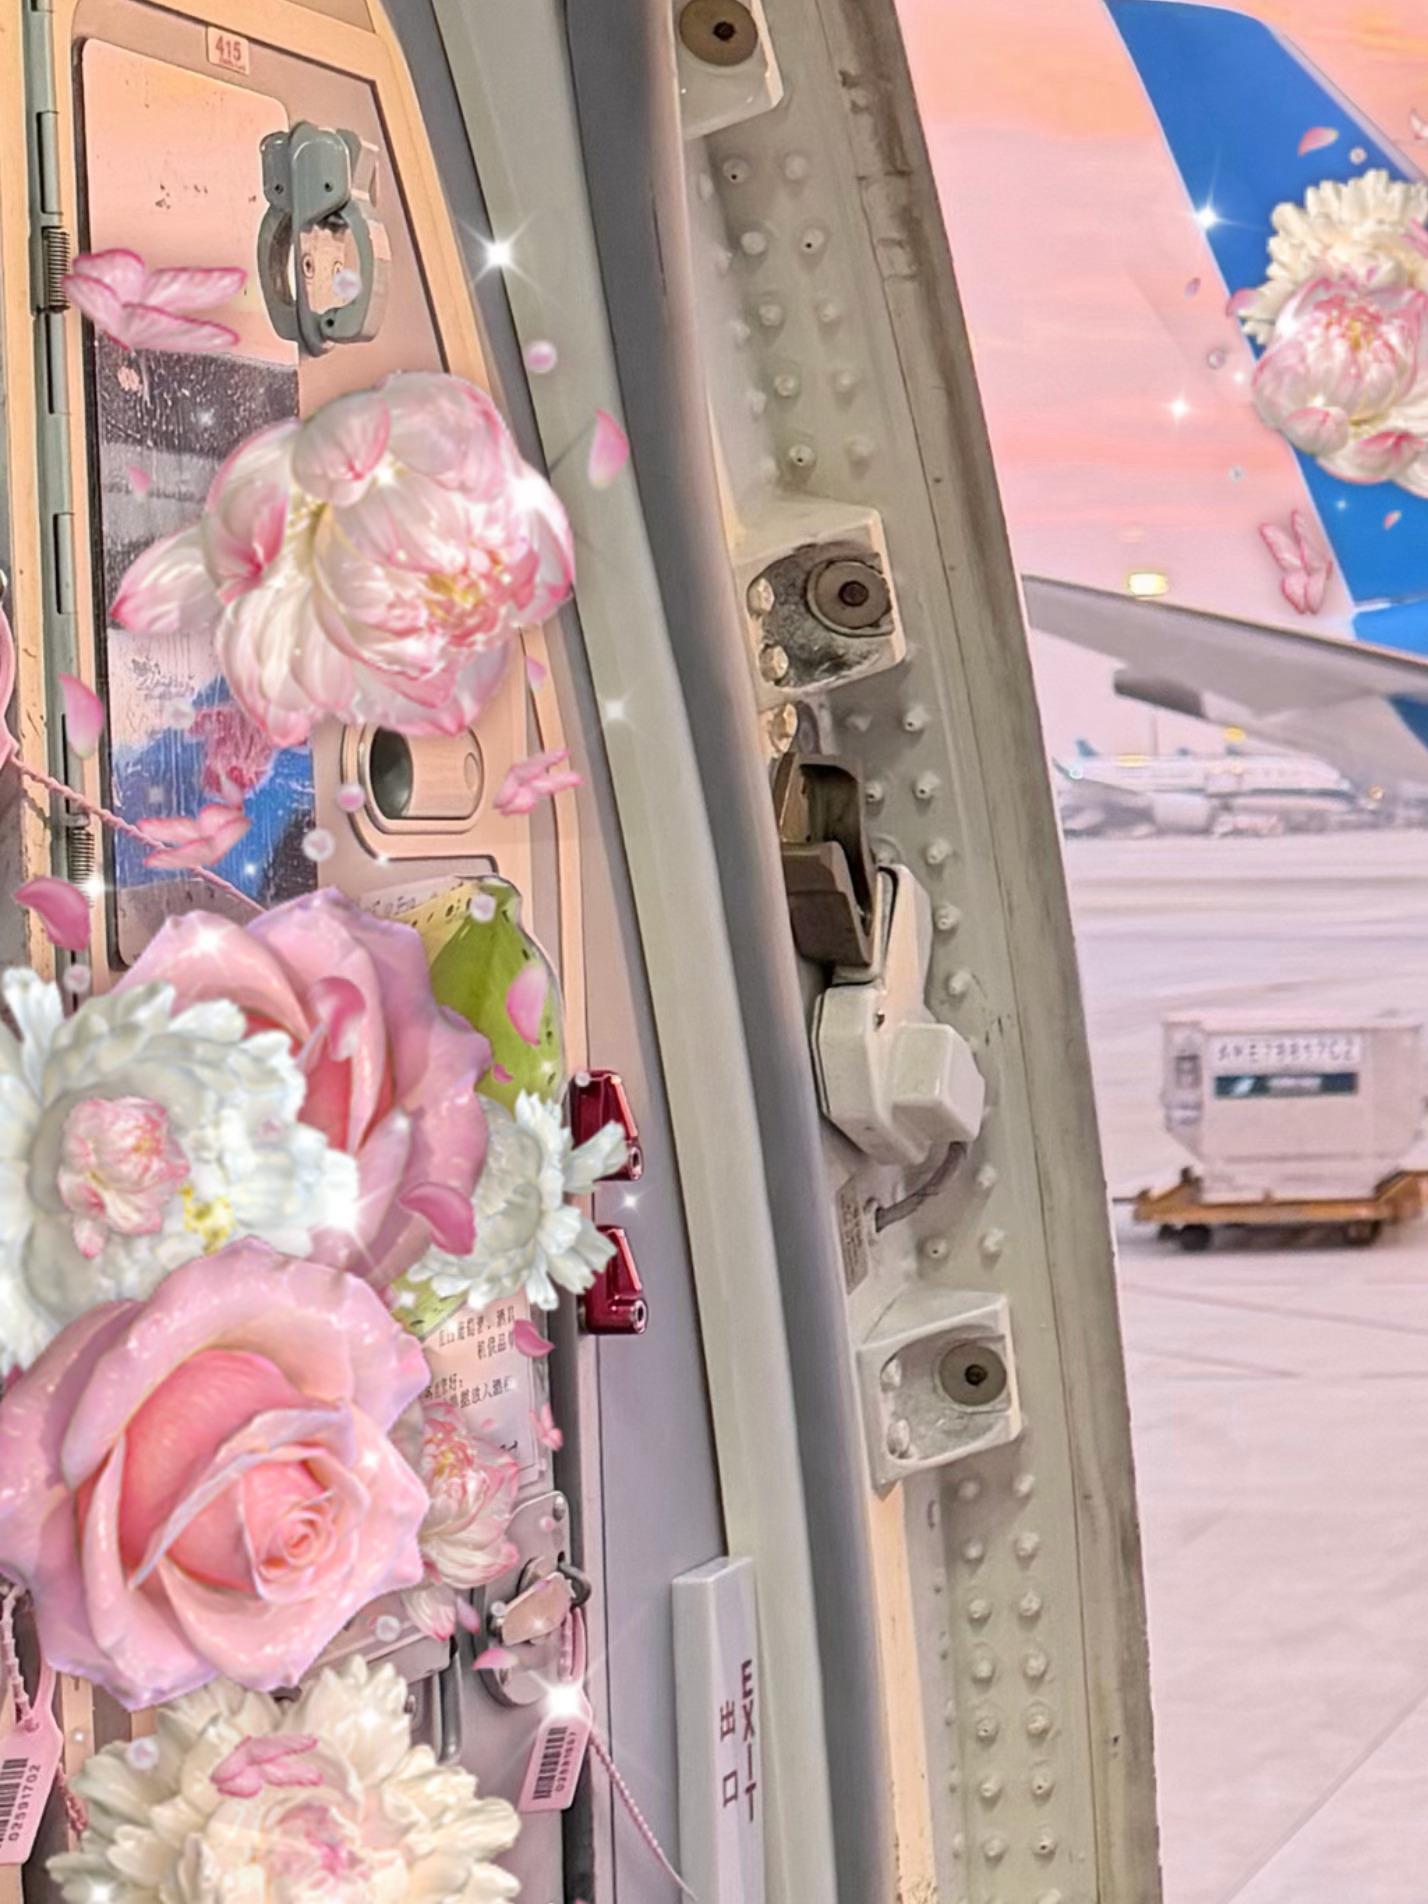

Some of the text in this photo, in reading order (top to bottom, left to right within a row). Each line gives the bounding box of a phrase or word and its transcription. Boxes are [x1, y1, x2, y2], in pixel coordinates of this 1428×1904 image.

[215, 35, 242, 61] 415
[719, 1698, 738, 1808] 出口
[741, 1658, 757, 1823] EXIT
